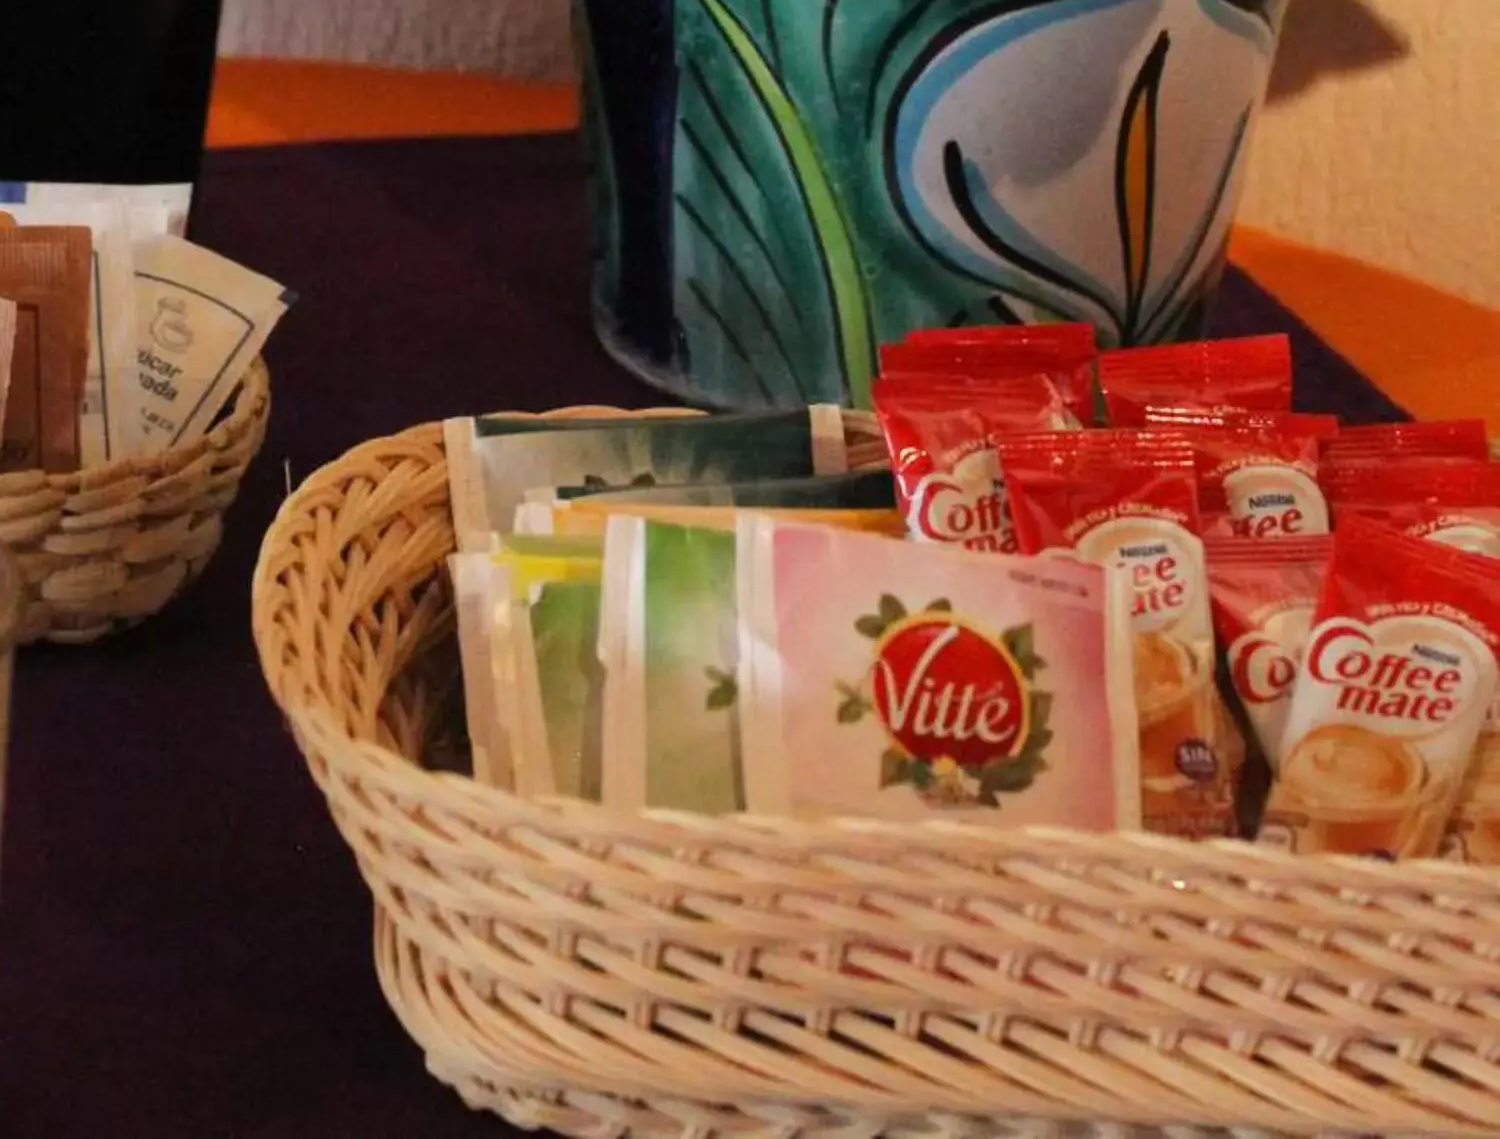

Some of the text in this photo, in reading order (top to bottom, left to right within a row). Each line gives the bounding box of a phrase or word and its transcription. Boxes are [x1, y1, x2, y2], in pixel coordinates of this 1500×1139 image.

[137, 347, 184, 380] úcar
[920, 480, 1013, 543] Coff
[963, 527, 1021, 554] ma
[1307, 625, 1462, 693] Coffee
[1336, 684, 1454, 724] mate
